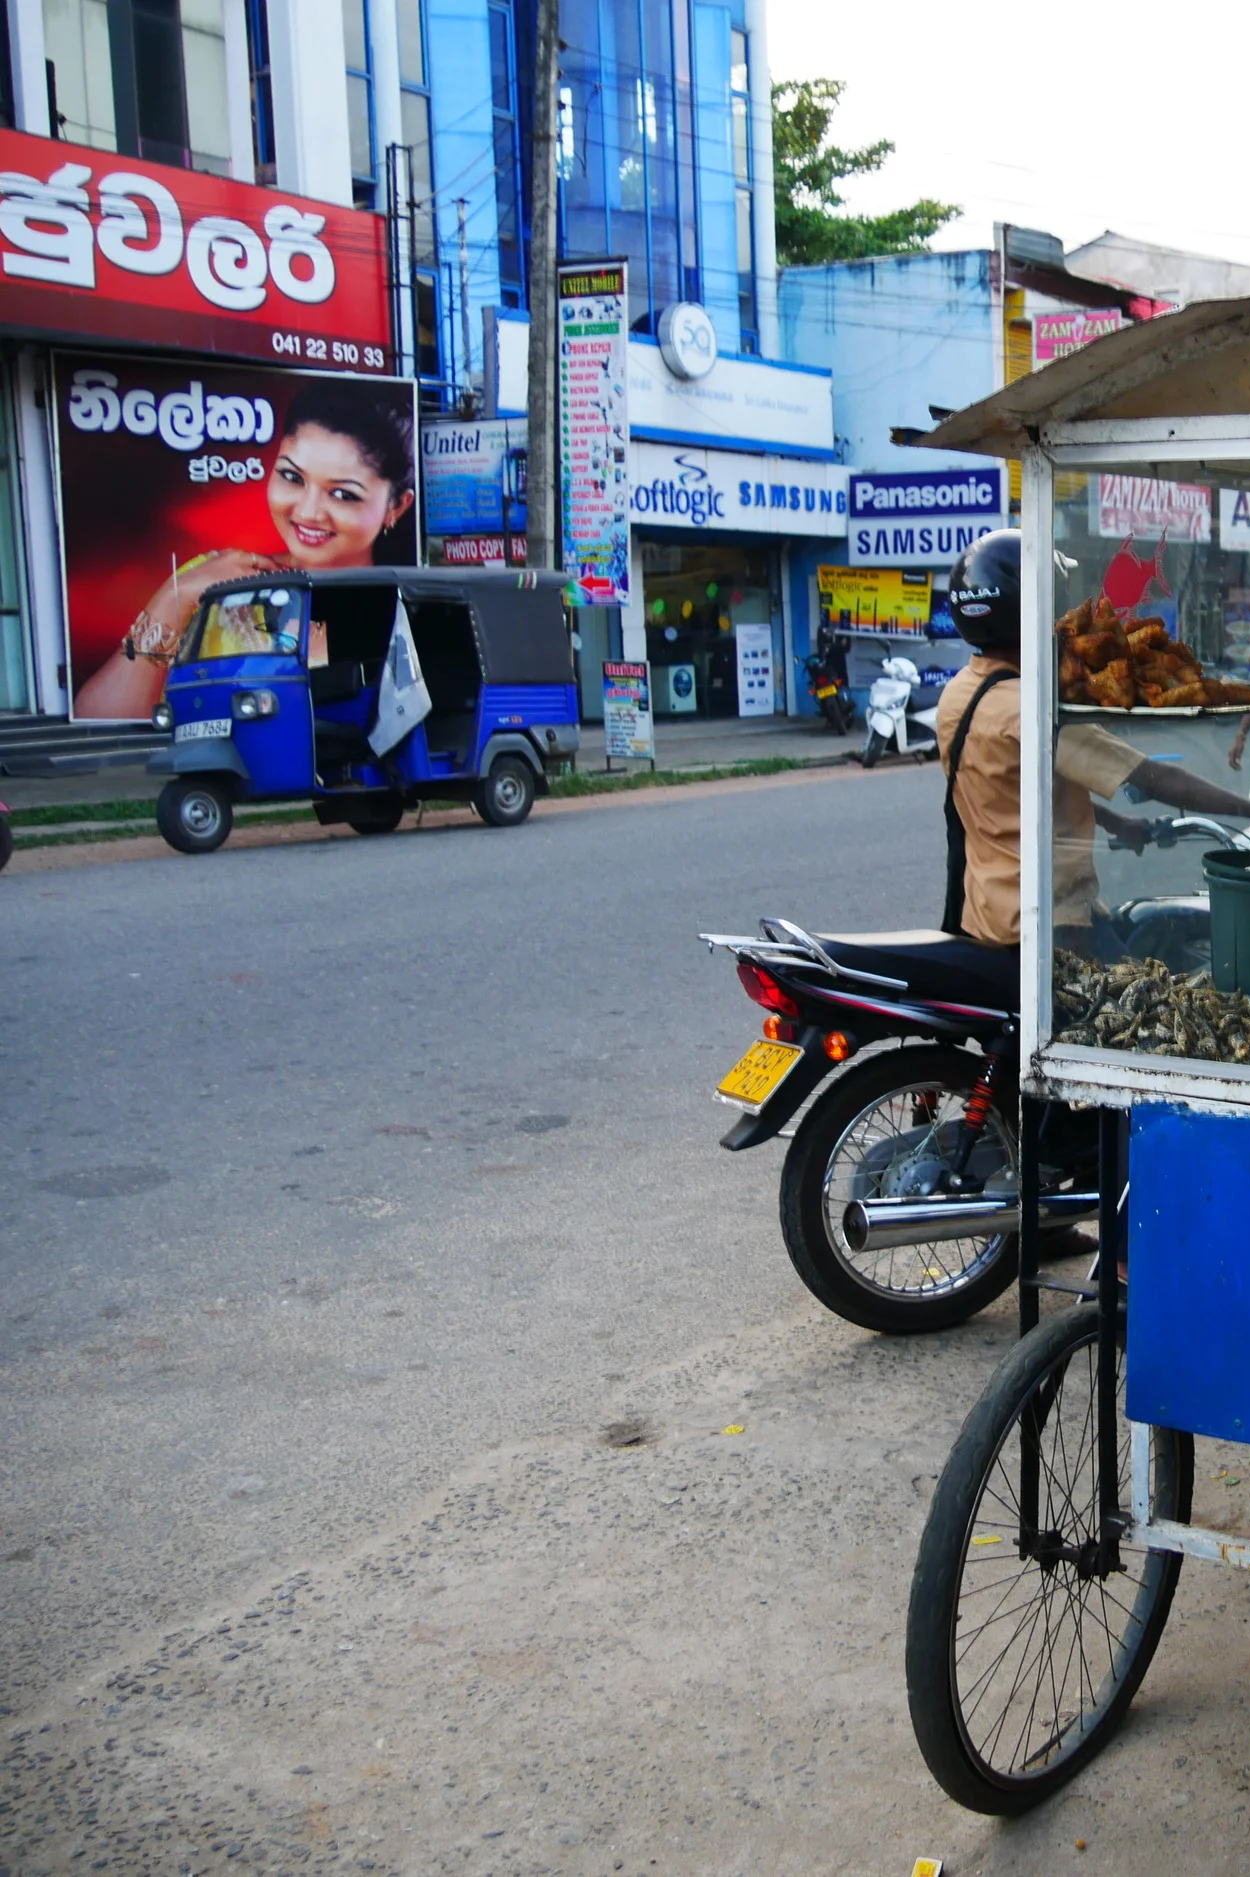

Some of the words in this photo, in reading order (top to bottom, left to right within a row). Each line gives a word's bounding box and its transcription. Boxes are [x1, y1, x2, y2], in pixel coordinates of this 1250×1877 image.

[1040, 322, 1071, 339] ZAM
[1084, 319, 1116, 336] ZAM
[272, 332, 300, 356] 041
[306, 338, 327, 360] 22
[333, 342, 359, 364] 510
[364, 347, 384, 369] 33
[69, 369, 274, 451] නිලේකා
[423, 429, 480, 455] Unitel
[630, 479, 724, 525] oftlogic
[739, 481, 846, 514] SAMSUNG
[855, 477, 993, 511] Panasonic
[1102, 473, 1132, 509] ZAM
[1140, 477, 1169, 511] ZAM
[446, 540, 477, 560] PHOTO
[479, 538, 505, 558] COPY
[959, 587, 1000, 601] BAJAJ
